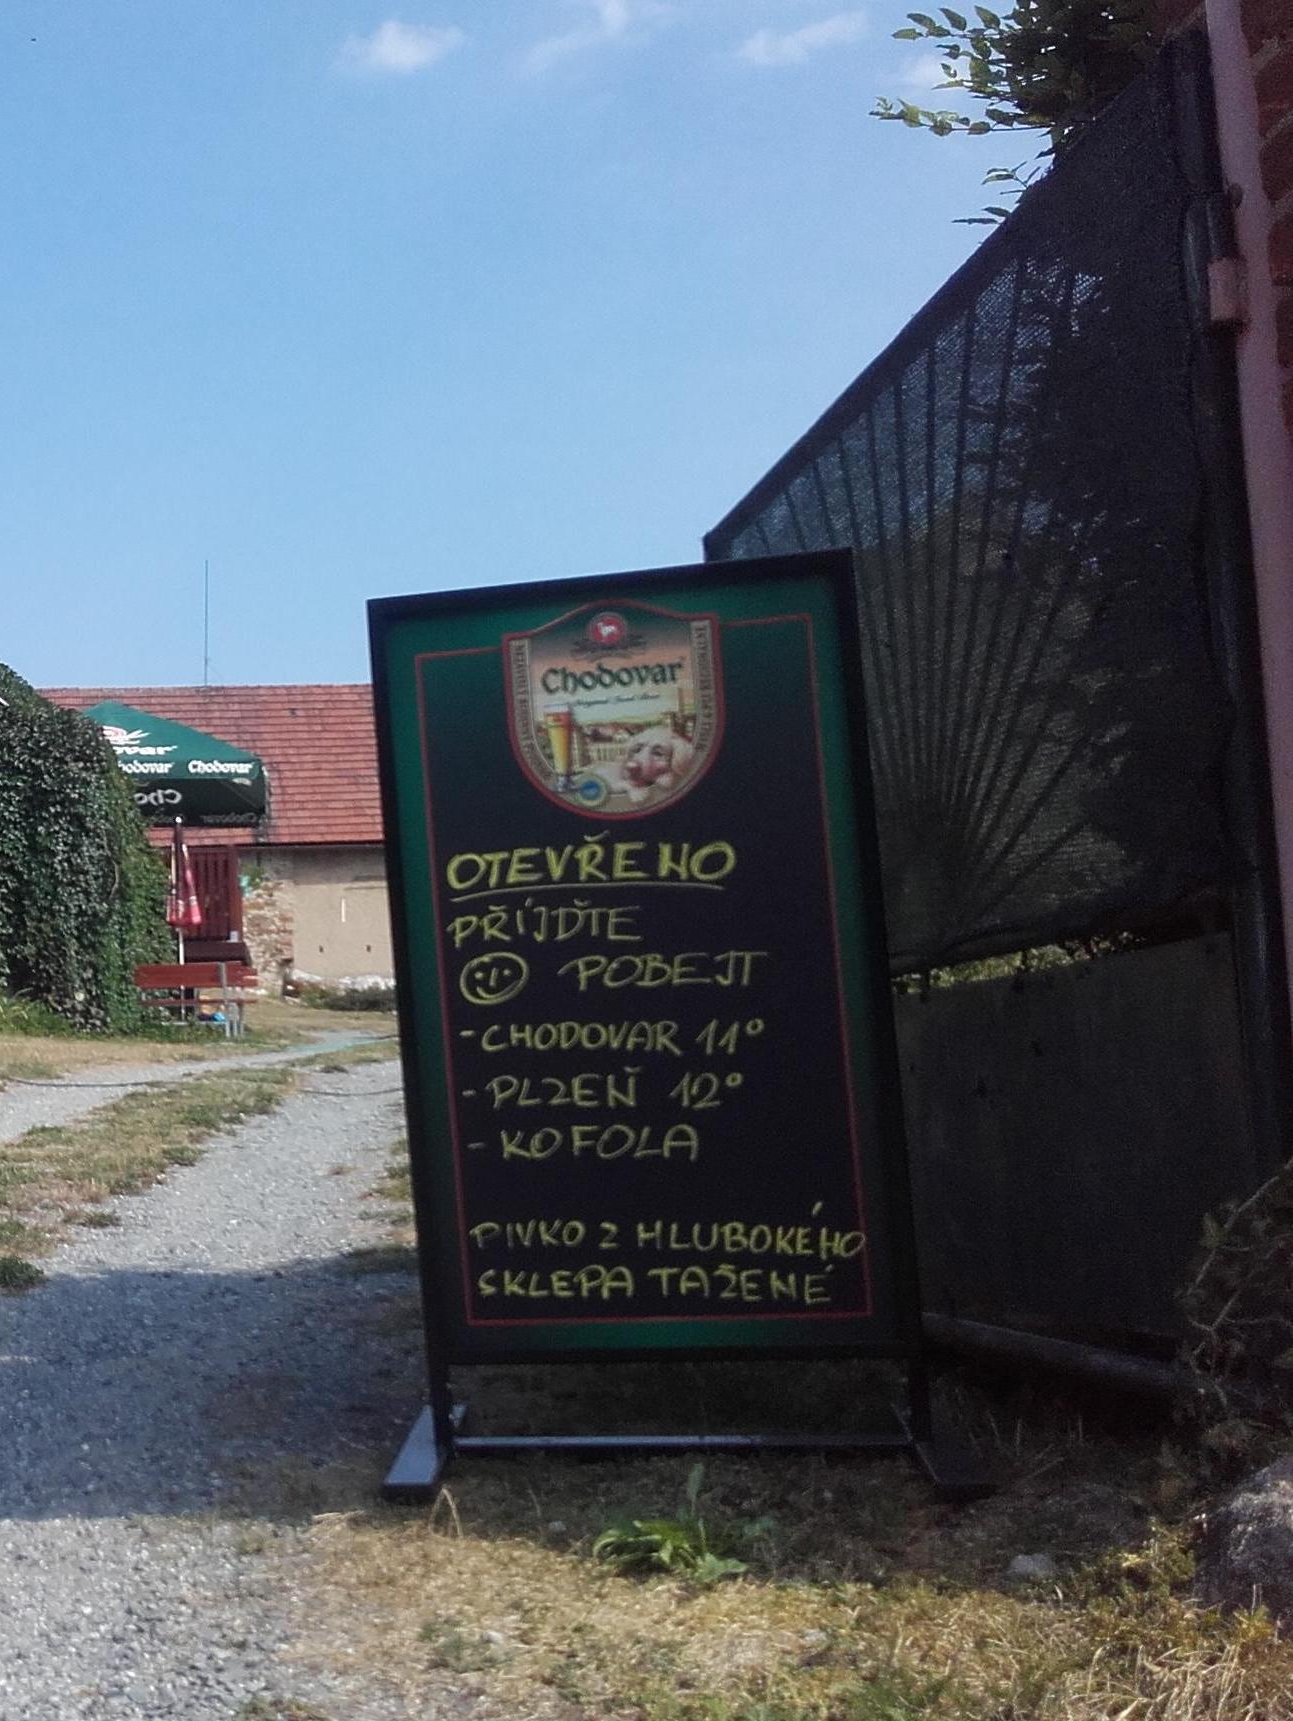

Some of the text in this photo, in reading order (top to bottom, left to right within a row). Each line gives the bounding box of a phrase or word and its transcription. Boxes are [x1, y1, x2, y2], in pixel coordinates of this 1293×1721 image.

[541, 658, 683, 694] Chodovar
[118, 760, 256, 775] hodovar Chodovar
[446, 831, 737, 890] OTEVŘENO
[557, 951, 768, 991] POBEJT
[481, 1020, 682, 1056] CHODOVAR
[500, 1124, 699, 1162] KOFOLA
[469, 1219, 587, 1250] PIVKO
[636, 1201, 867, 1261] HLUBOKÉHO
[478, 1263, 834, 1305] SKLEPA TAŽENÉ
